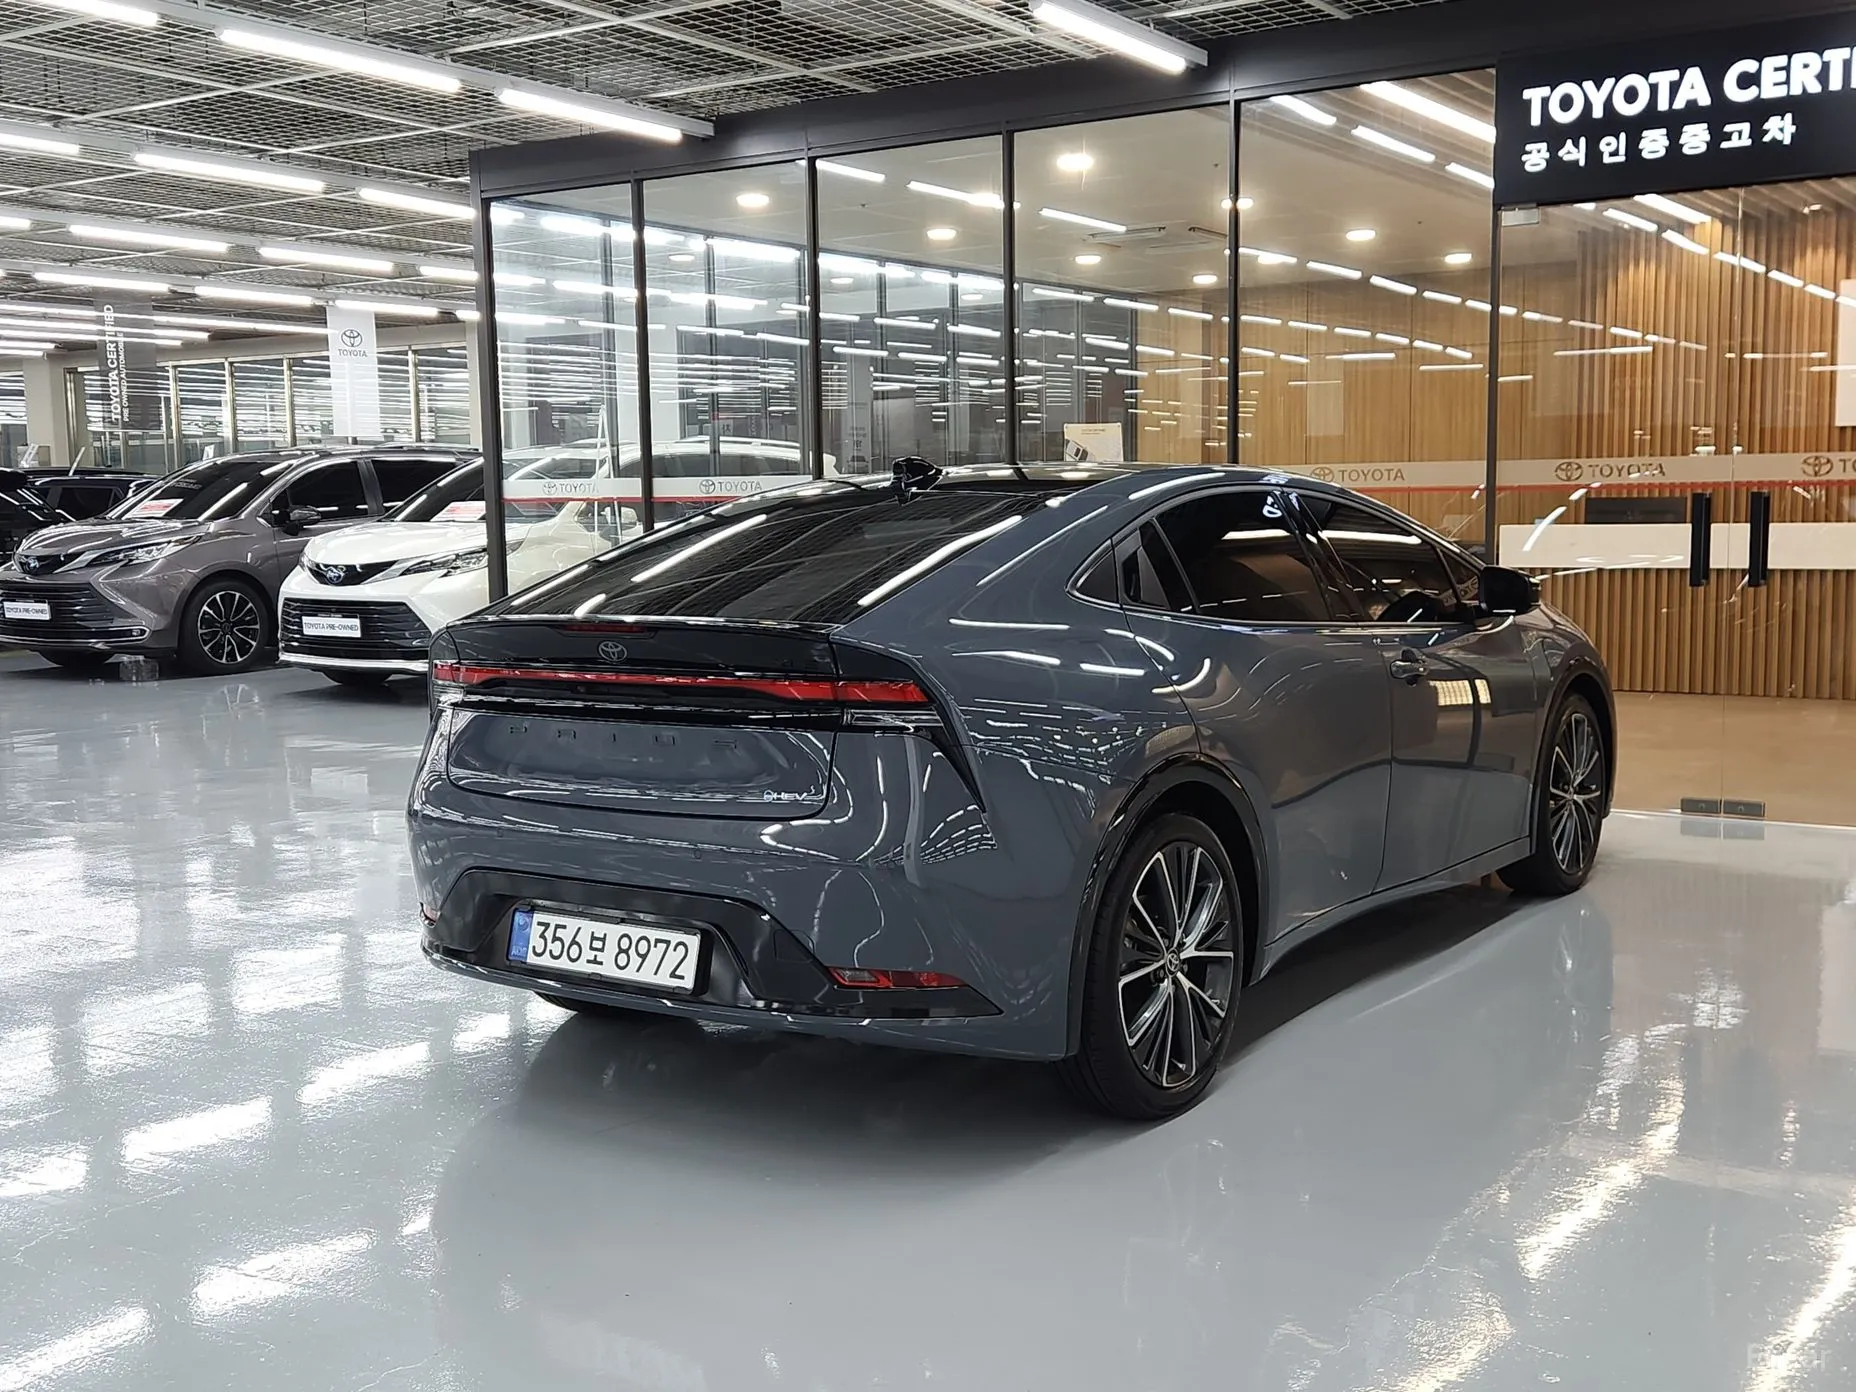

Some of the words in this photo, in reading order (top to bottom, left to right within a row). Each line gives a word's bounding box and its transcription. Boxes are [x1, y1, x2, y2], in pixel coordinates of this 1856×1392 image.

[1521, 65, 1712, 127] TOYOTA
[104, 304, 117, 368] CERTIFIED
[117, 332, 127, 379] AUTOMOBE
[338, 348, 368, 358] TOYOTA
[108, 369, 121, 422] TOYOTA
[1338, 468, 1405, 482] TOYOTA
[1588, 463, 1665, 478] TOYOTA
[559, 481, 599, 493] TOYOTA
[718, 480, 762, 492] TOYOTA
[304, 622, 326, 630] TOYOTA
[326, 623, 358, 631] PRE-OWNED
[531, 921, 607, 966] 356보
[614, 932, 690, 981] 8972
